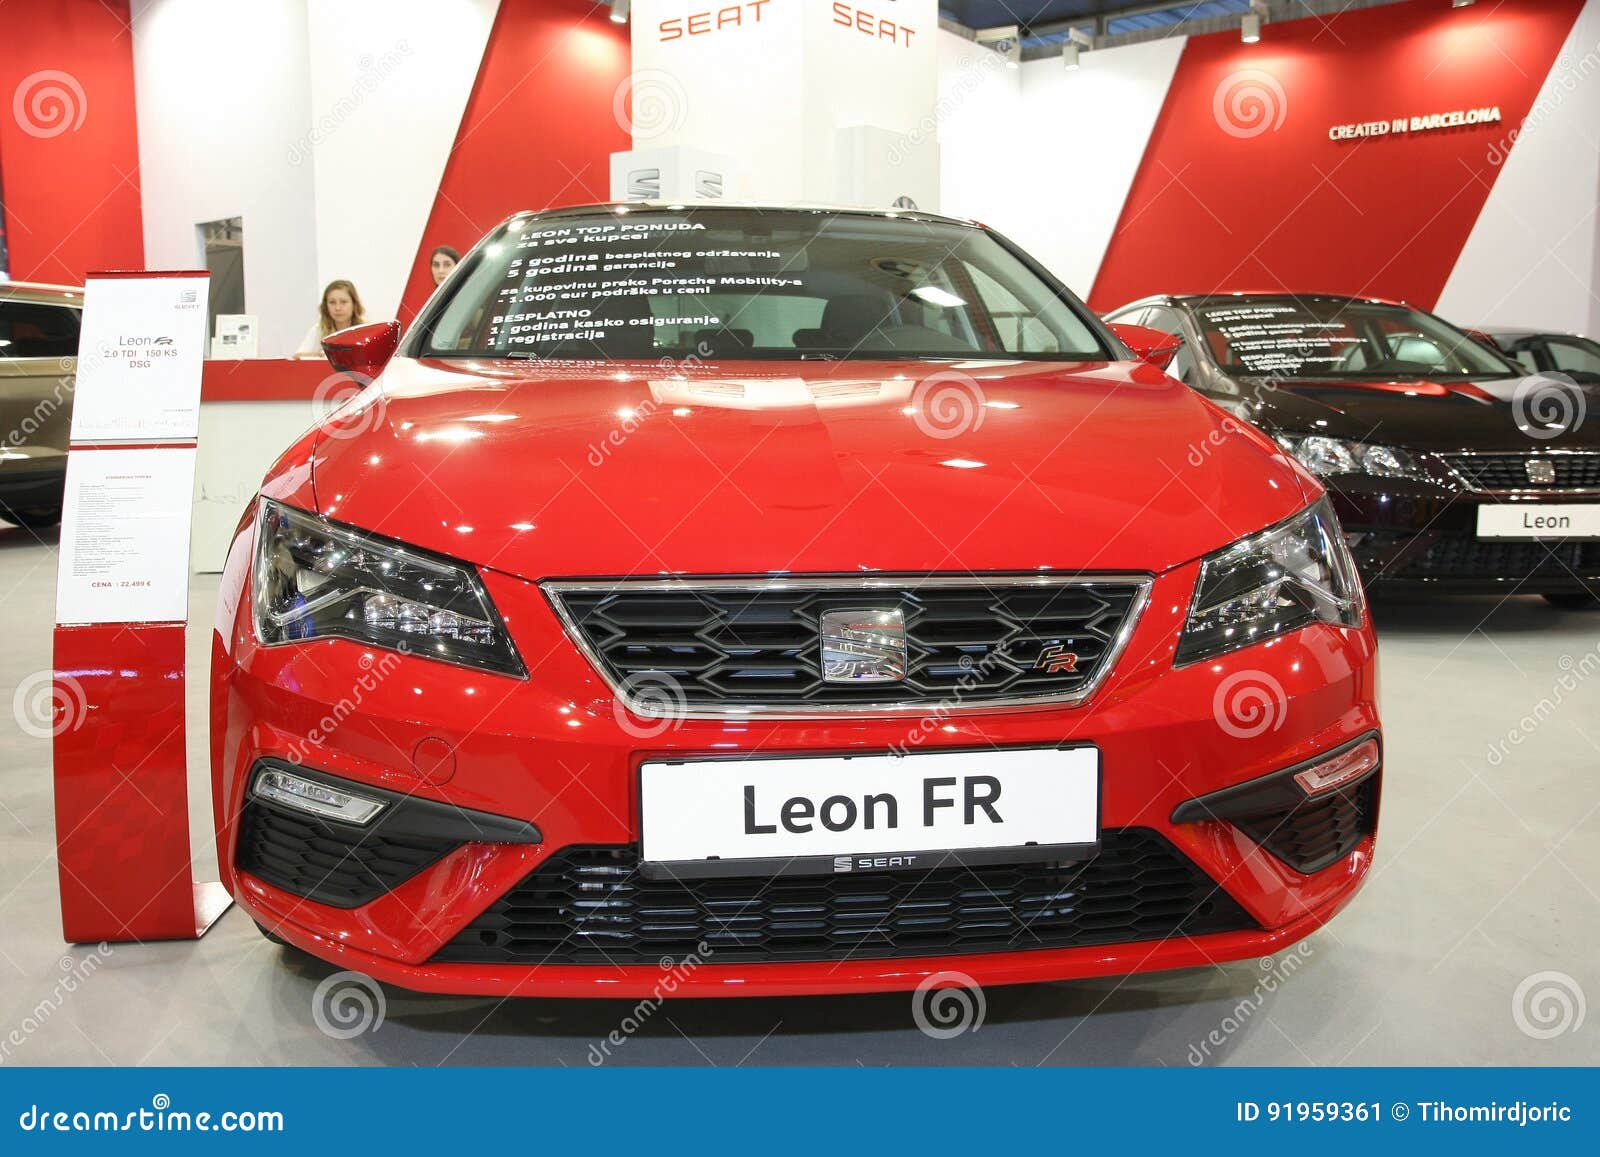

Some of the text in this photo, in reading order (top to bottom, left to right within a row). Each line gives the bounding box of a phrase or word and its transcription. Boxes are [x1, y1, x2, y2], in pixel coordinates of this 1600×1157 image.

[659, 0, 770, 42] SEAT
[833, 2, 915, 48] SEAT
[1329, 106, 1501, 140] CREATED IN BARCELONA
[520, 223, 706, 241] LEON TOP PONUDA
[516, 241, 538, 249] za
[544, 237, 578, 247] sve
[510, 258, 523, 268] 5
[529, 254, 599, 268] godina
[605, 250, 691, 261] besplatnog
[507, 260, 676, 278] 5 godina garancije
[500, 277, 803, 296] za kupovinu preko Porsche Mobility-a
[509, 294, 556, 304] 1.000
[560, 290, 587, 300] eur
[490, 315, 720, 335] 1. godina kasko osiguranje
[492, 309, 592, 324] BESPLATNO
[119, 335, 152, 346] Leon
[487, 329, 606, 346] 1. registracija
[104, 349, 178, 358] 2.0 TDI 150 KS
[129, 360, 151, 368] DSG
[1523, 512, 1570, 529] Leon
[1033, 644, 1080, 673] FR
[743, 775, 1004, 835] Leon FR
[858, 855, 917, 869] SEAT
